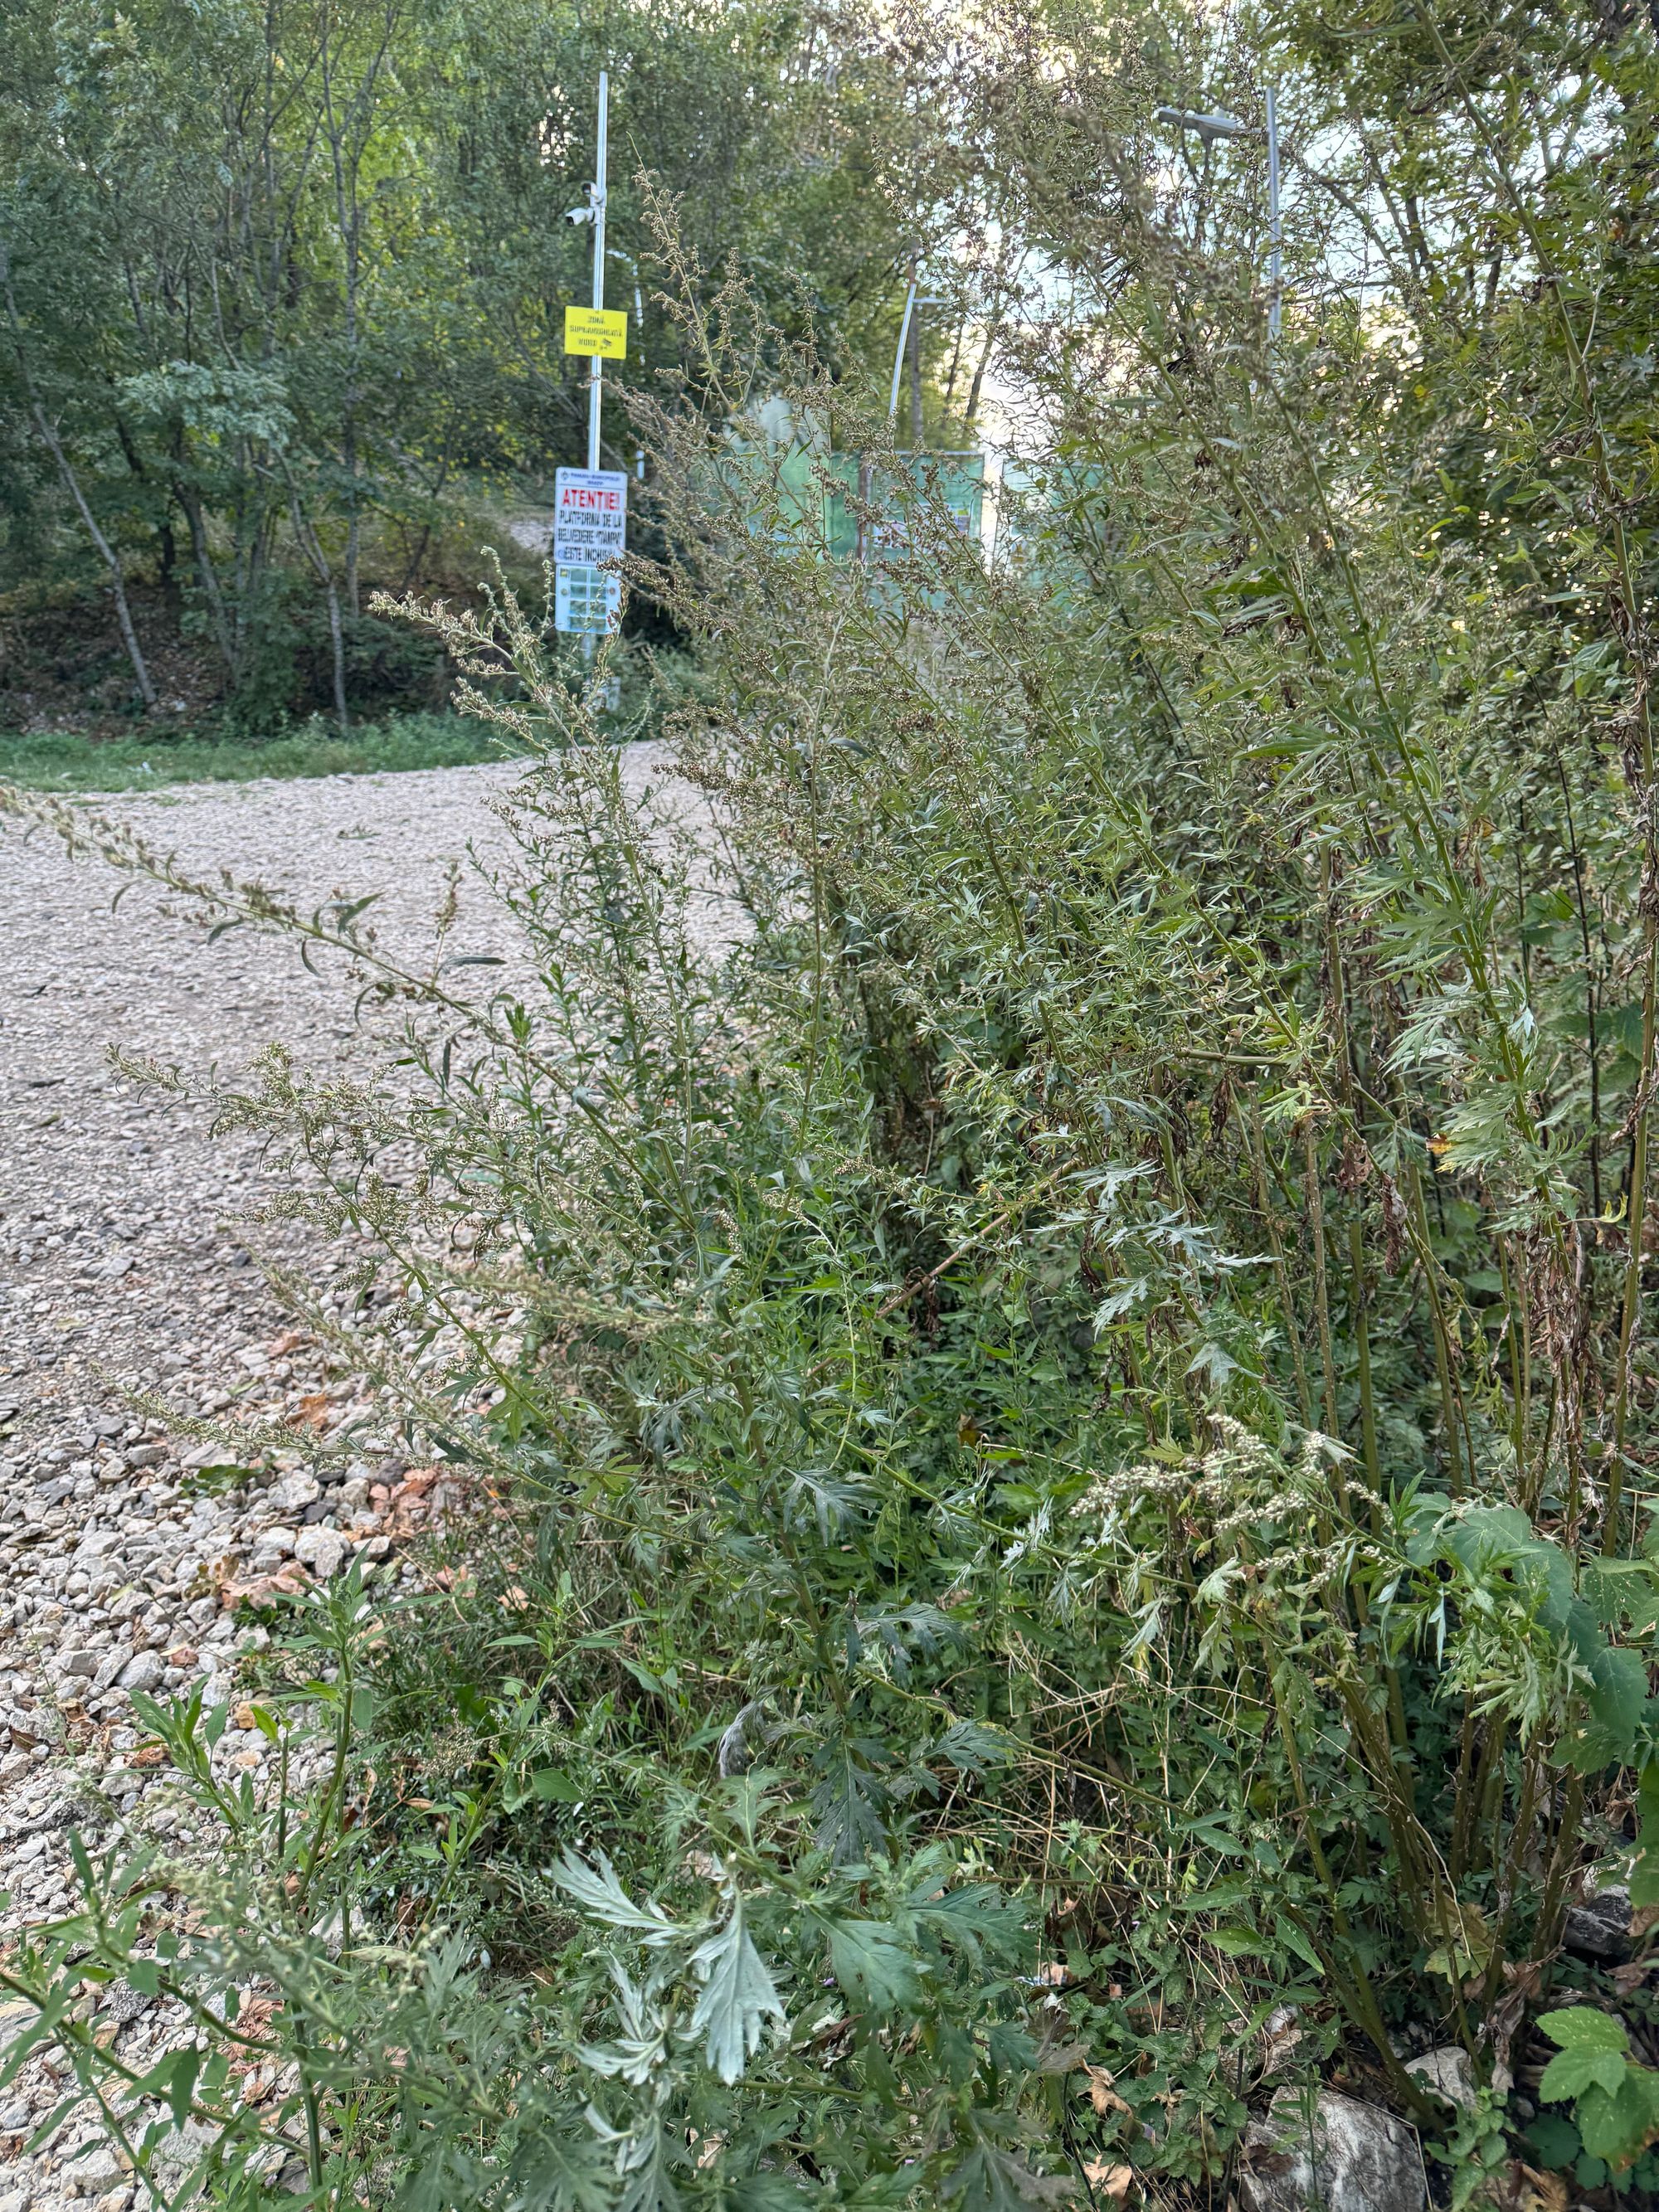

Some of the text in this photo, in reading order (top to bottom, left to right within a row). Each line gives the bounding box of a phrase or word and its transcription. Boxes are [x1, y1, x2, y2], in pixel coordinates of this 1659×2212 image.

[603, 513, 611, 528] DE
[614, 514, 622, 529] LA
[558, 527, 595, 545] BELVEDERE
[564, 546, 582, 561] ESTE
